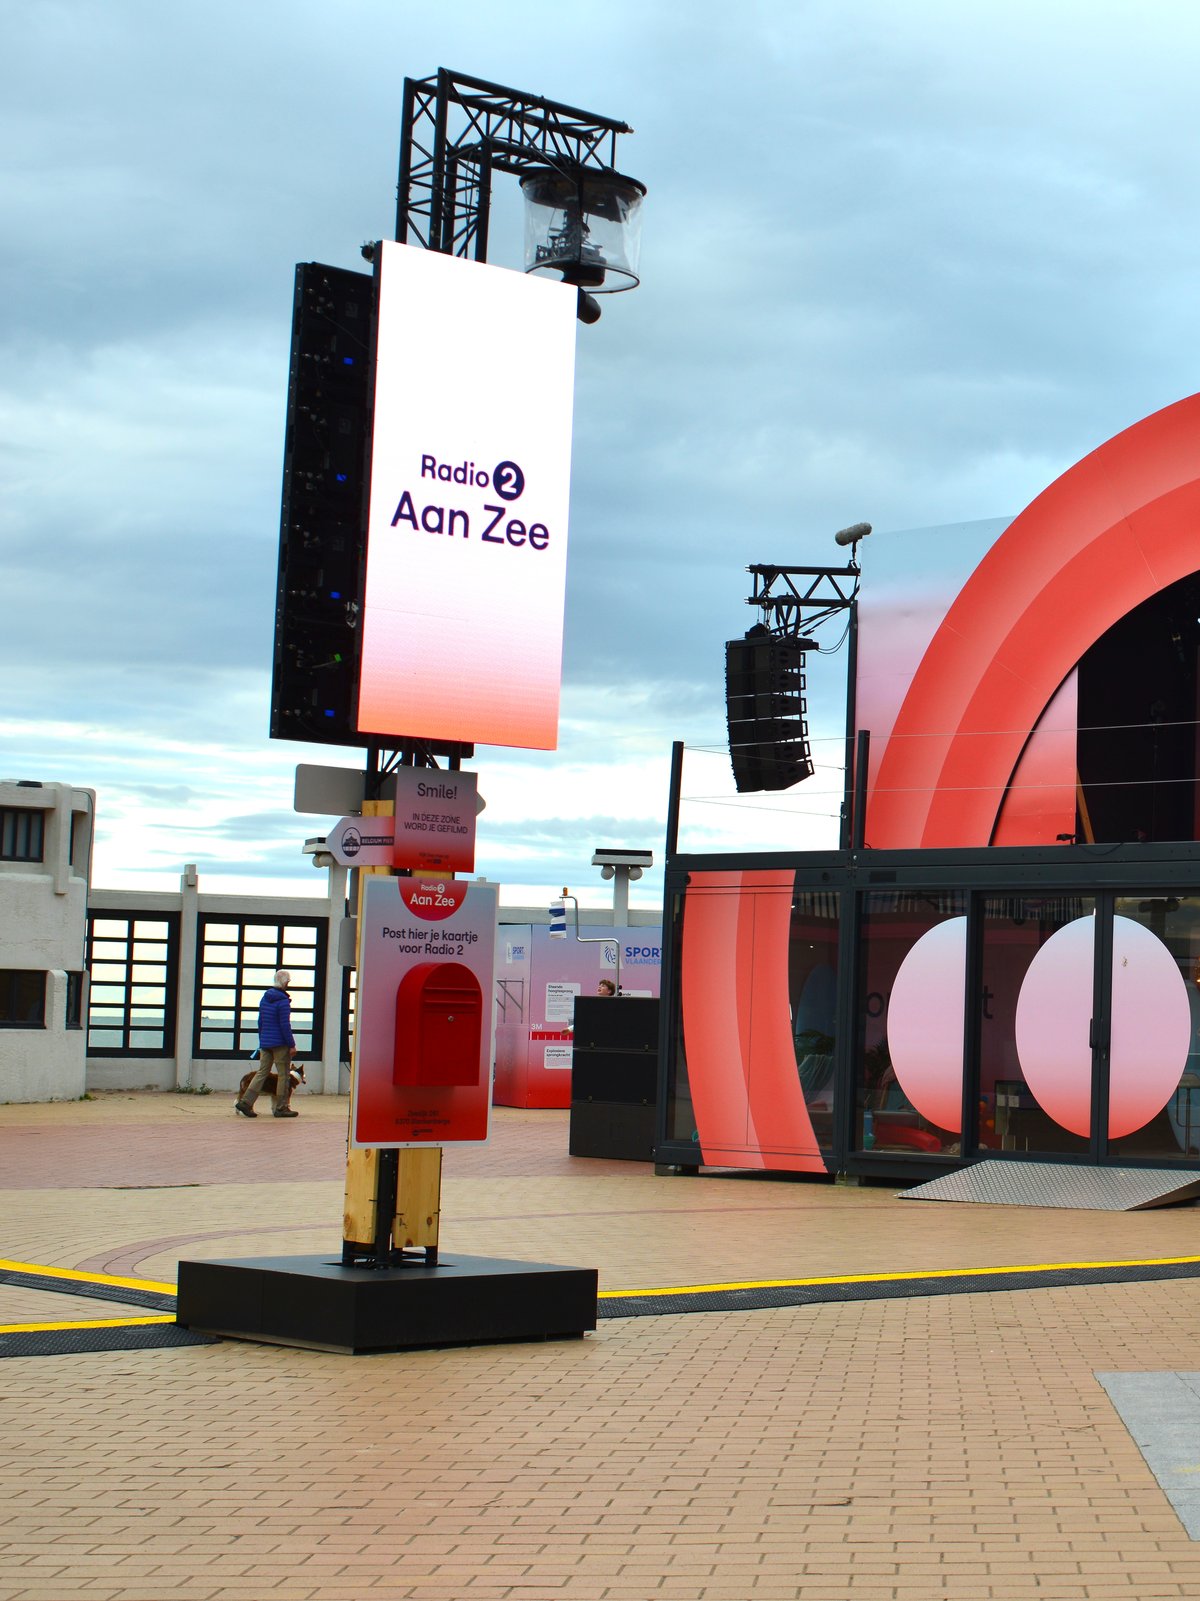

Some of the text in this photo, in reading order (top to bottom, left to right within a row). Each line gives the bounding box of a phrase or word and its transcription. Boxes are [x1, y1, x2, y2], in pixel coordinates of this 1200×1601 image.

[421, 454, 522, 498] Radio 2
[391, 490, 550, 551] Aan Zee
[417, 782, 458, 799] Smile!
[412, 812, 461, 824] IN DEZE ZONE
[404, 822, 468, 834] WORD JE GEFILMD
[438, 884, 445, 893] 2
[410, 893, 455, 907] Aan Zee
[382, 927, 478, 944] Post hier je kaartje
[399, 943, 464, 955] voor Radio 2
